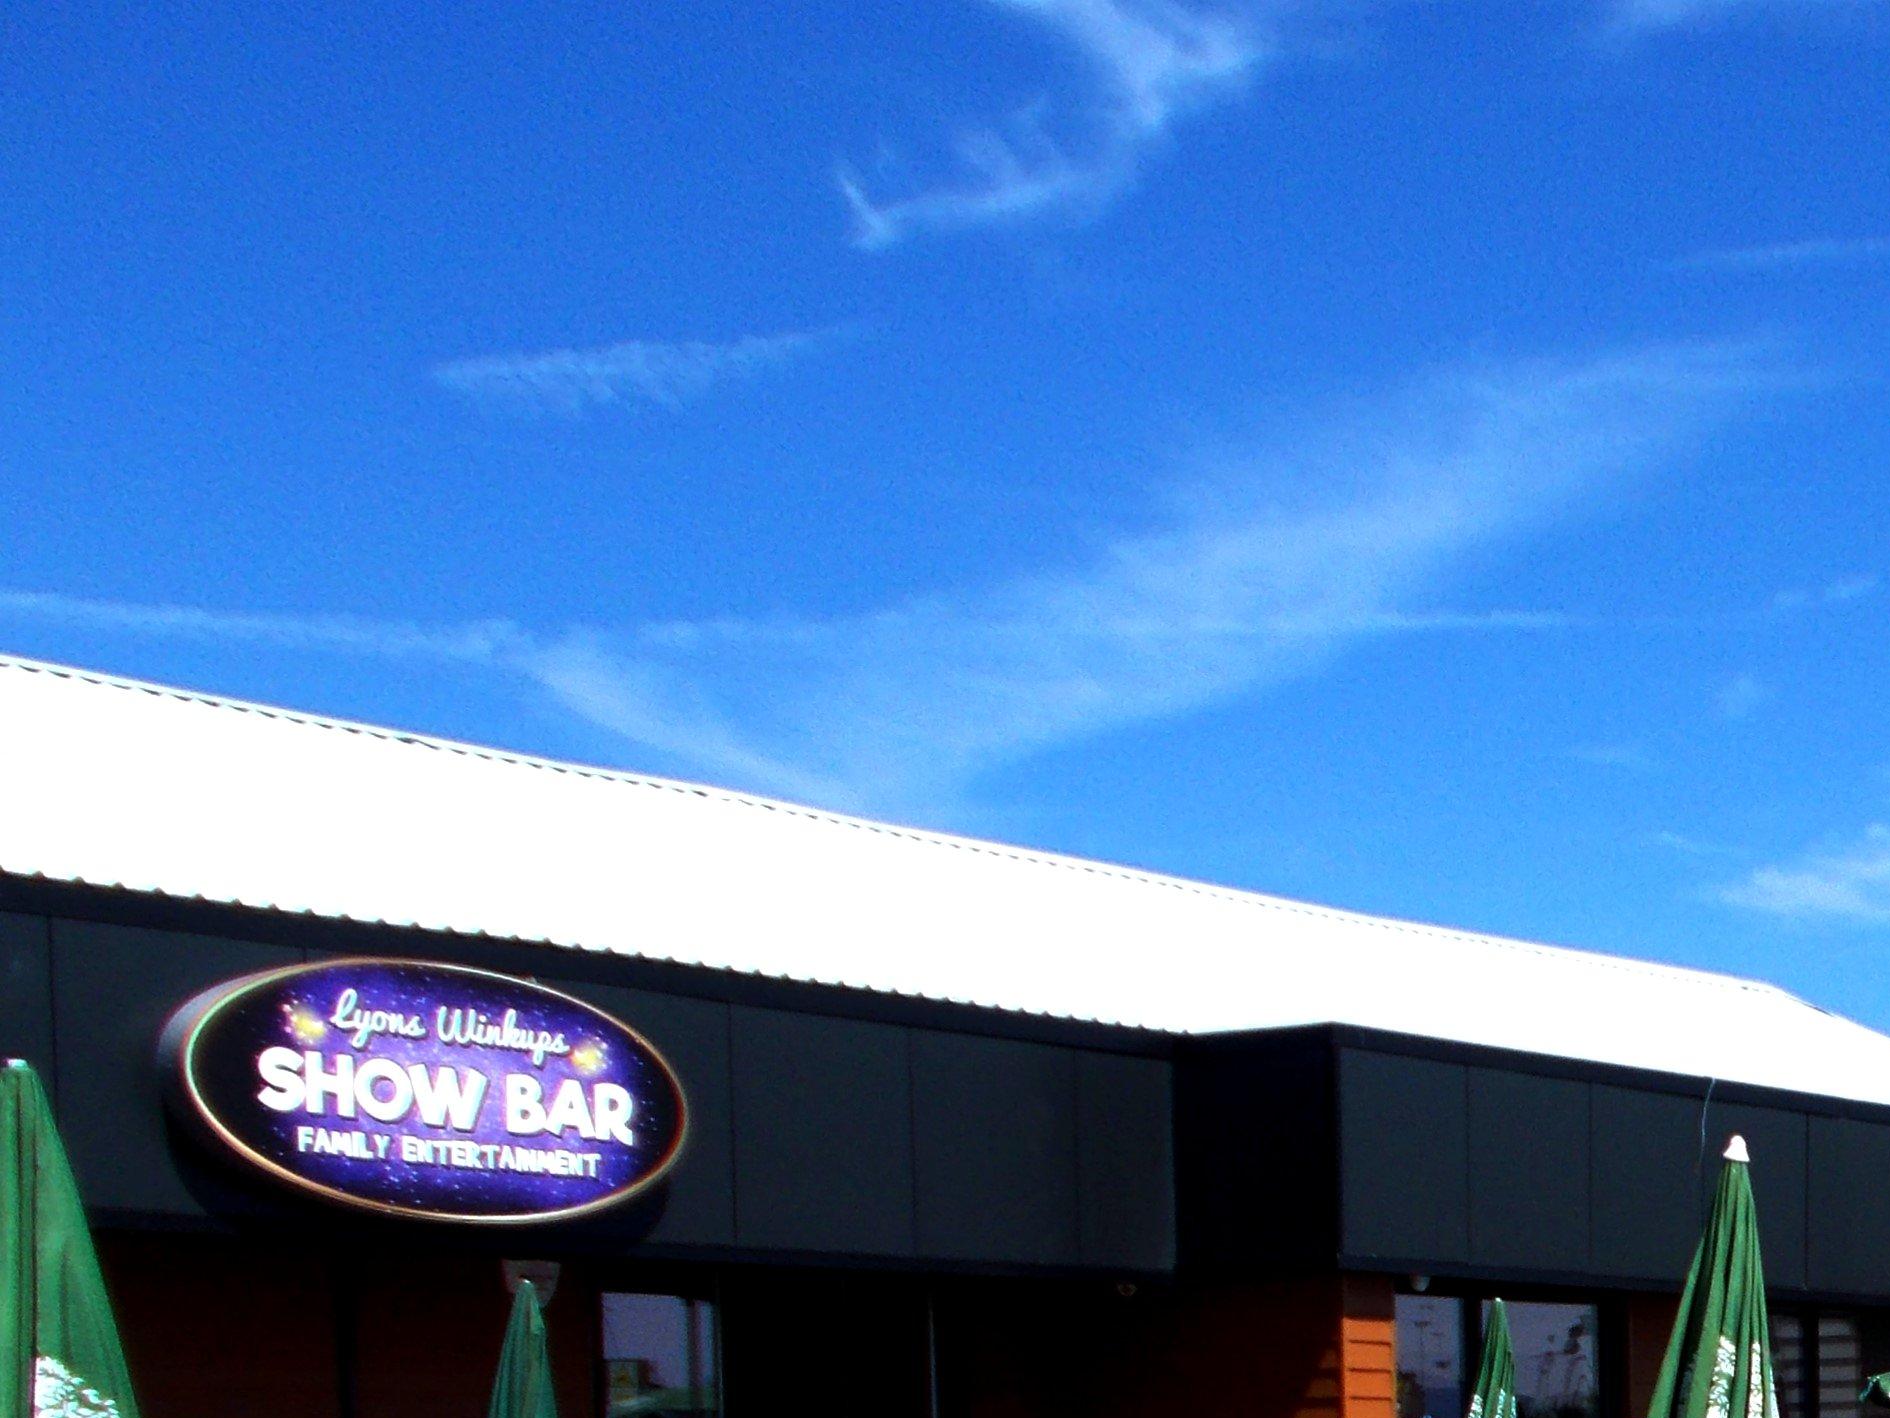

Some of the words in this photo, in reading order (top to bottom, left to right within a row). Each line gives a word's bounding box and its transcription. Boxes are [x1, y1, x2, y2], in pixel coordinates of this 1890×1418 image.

[328, 988, 425, 1048] Lyons
[437, 1004, 569, 1067] Winkups
[257, 1046, 488, 1134] SHOW
[505, 1073, 634, 1146] BAR
[297, 1126, 390, 1160] FAMILY
[402, 1136, 601, 1179] ENTERTAINMENT
